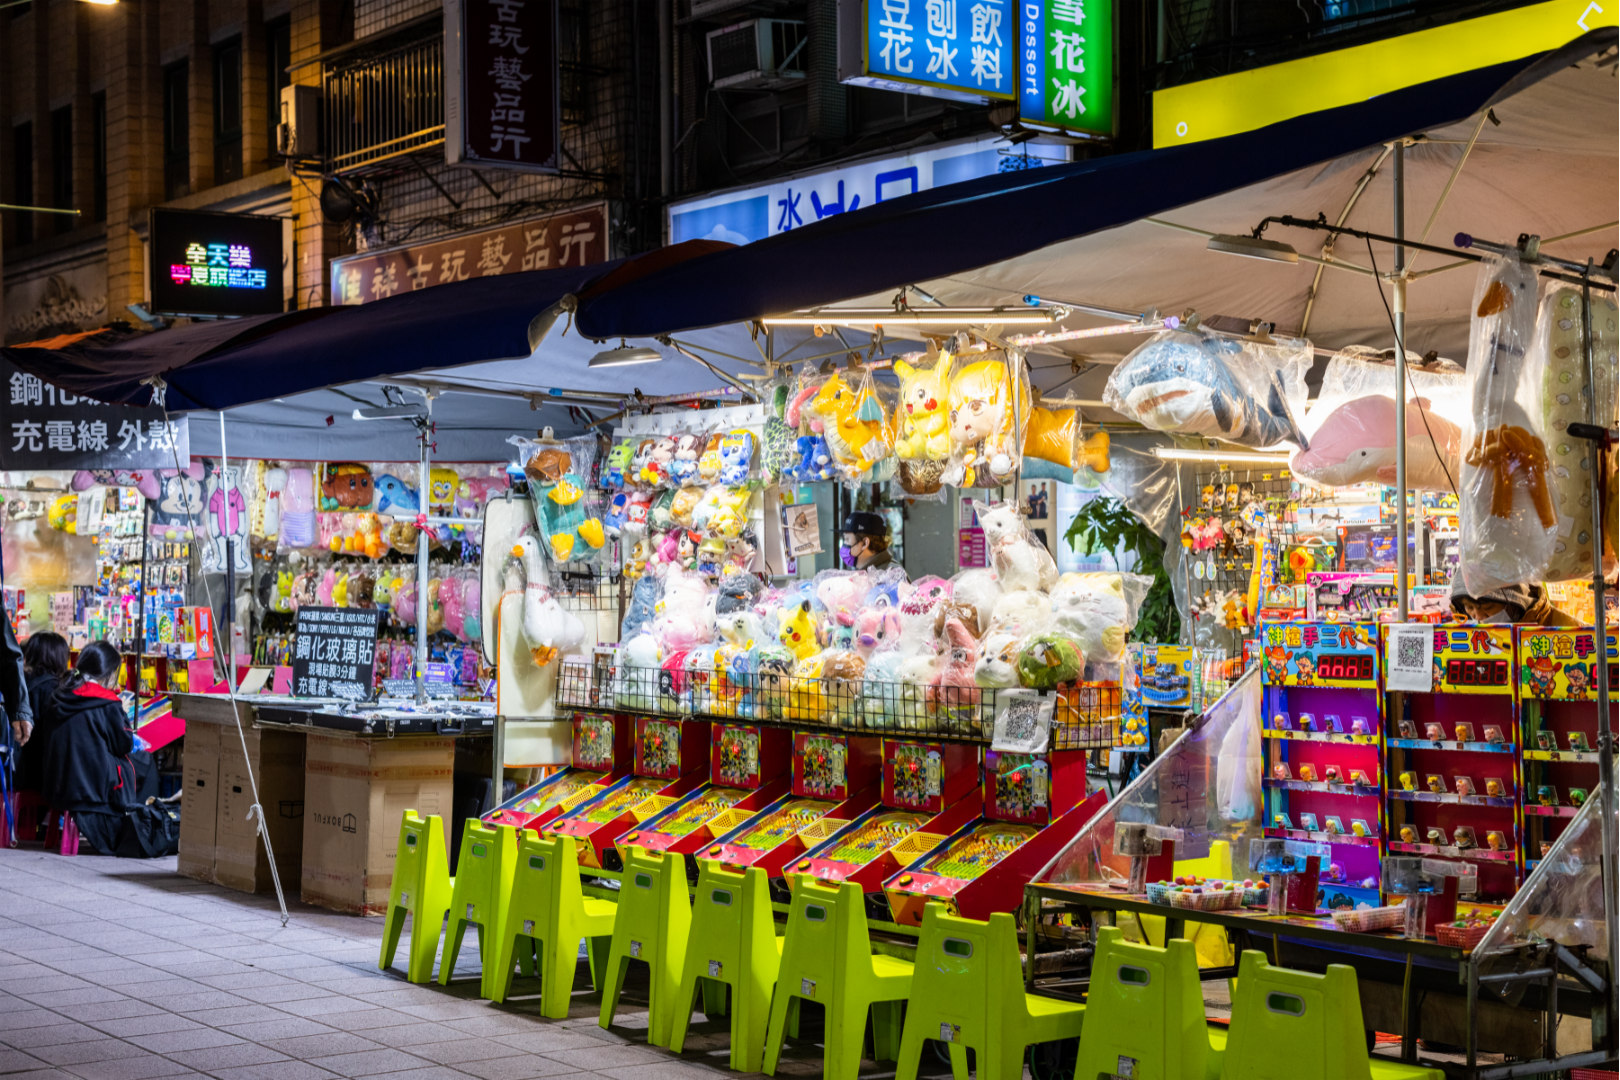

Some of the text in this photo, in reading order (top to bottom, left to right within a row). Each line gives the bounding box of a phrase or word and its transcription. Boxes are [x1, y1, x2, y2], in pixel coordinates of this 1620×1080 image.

[879, 0, 914, 74] 豆花
[925, 0, 959, 80] 刨冰
[969, 0, 1003, 89] 飲料
[1025, 3, 1040, 96] Dessert
[11, 419, 110, 452] 充電線
[117, 419, 179, 452] 外殼
[296, 635, 374, 665] 鋼化玻璃貼
[1267, 625, 1357, 649] 神槍手二代
[313, 812, 341, 827] BOXFUL
